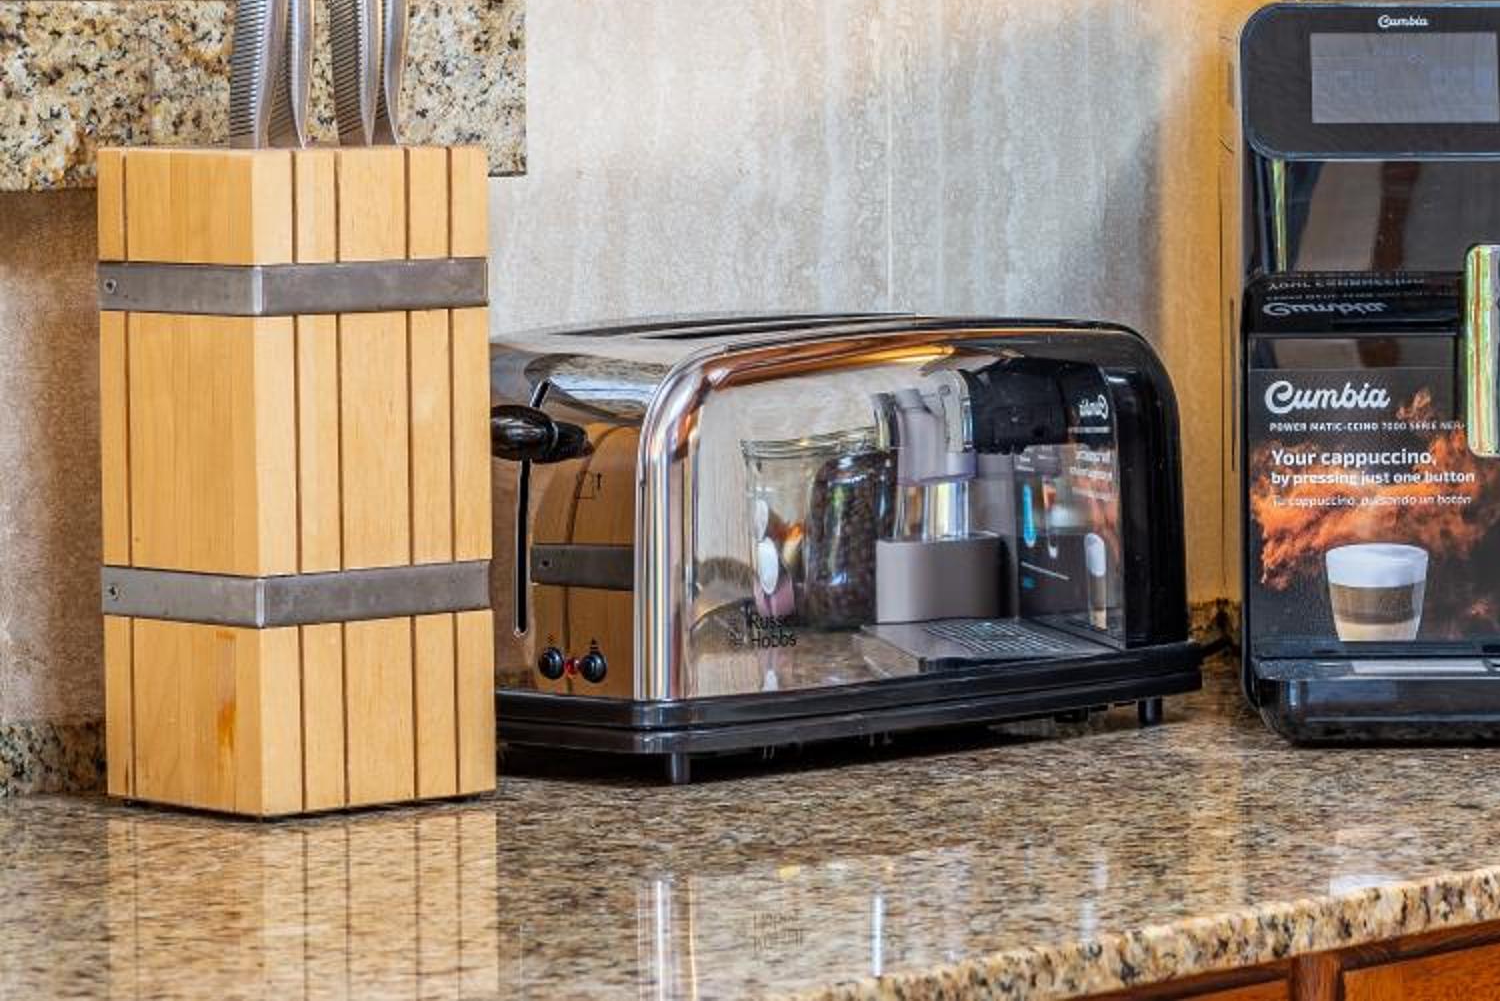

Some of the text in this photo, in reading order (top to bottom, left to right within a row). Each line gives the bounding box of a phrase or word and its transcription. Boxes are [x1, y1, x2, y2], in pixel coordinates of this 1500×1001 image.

[1377, 14, 1429, 28] Cumbia
[1264, 380, 1391, 414] Cumbia
[1269, 422, 1307, 432] POWER
[1309, 421, 1378, 432] MATIC-CCINO
[1271, 448, 1437, 467] Your cappuccino,
[1271, 471, 1475, 487] by pressing just one button
